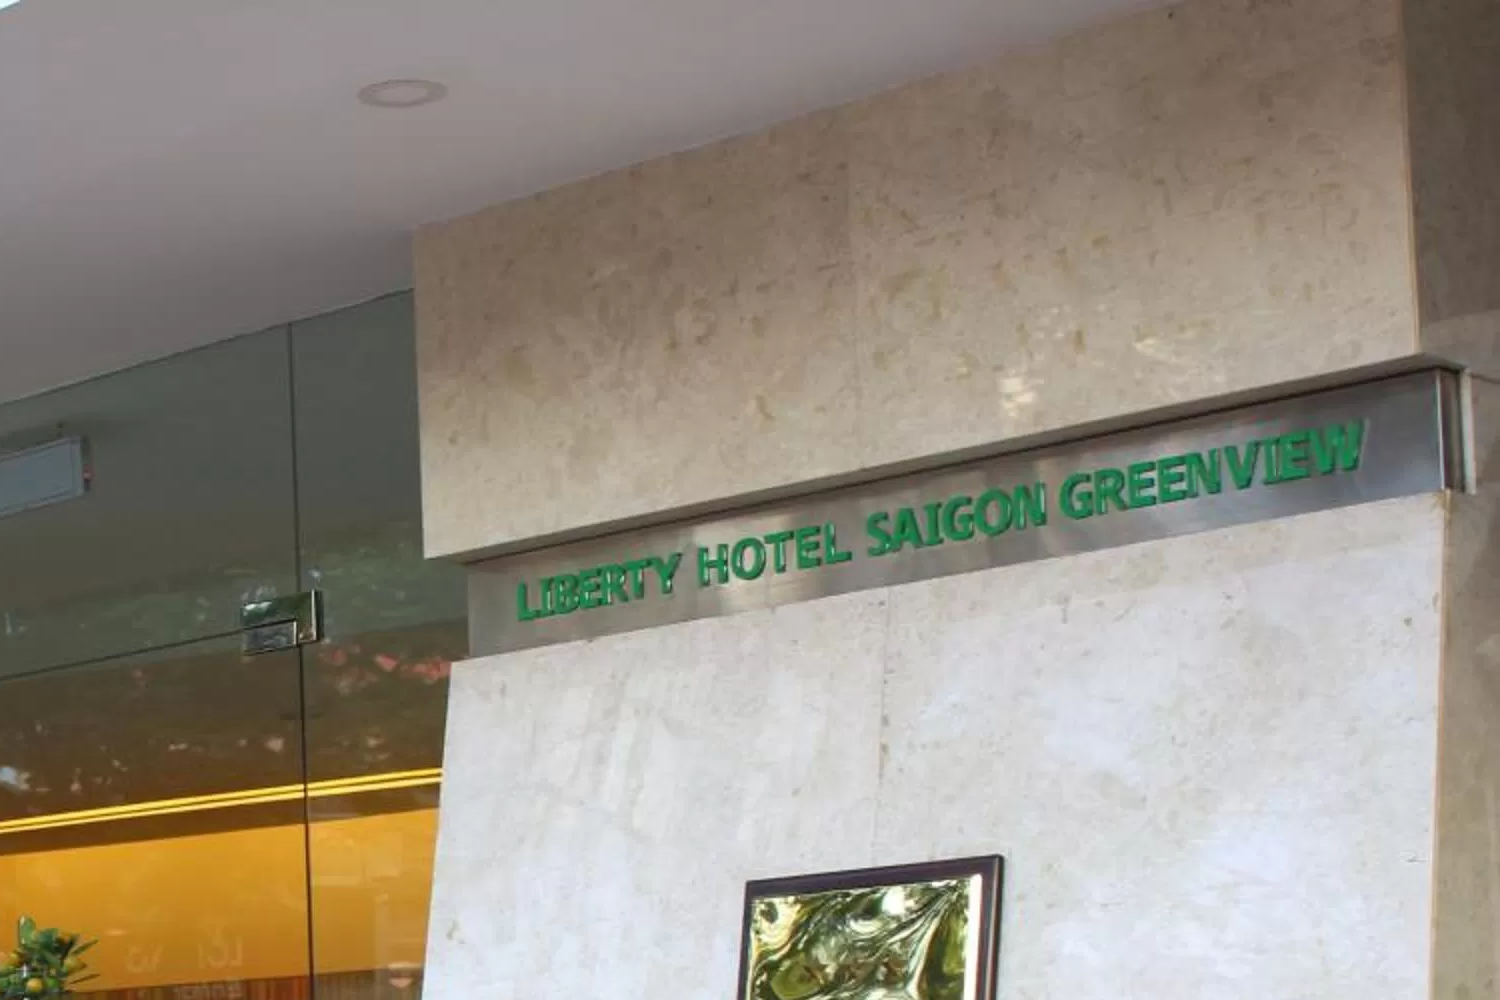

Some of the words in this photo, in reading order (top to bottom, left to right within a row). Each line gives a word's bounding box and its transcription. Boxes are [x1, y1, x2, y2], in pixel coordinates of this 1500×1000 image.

[516, 552, 683, 621] LIBERTY
[697, 522, 852, 588] HOTEL
[866, 481, 1047, 557] SAIGON
[1059, 418, 1366, 521] GREENVIEW
